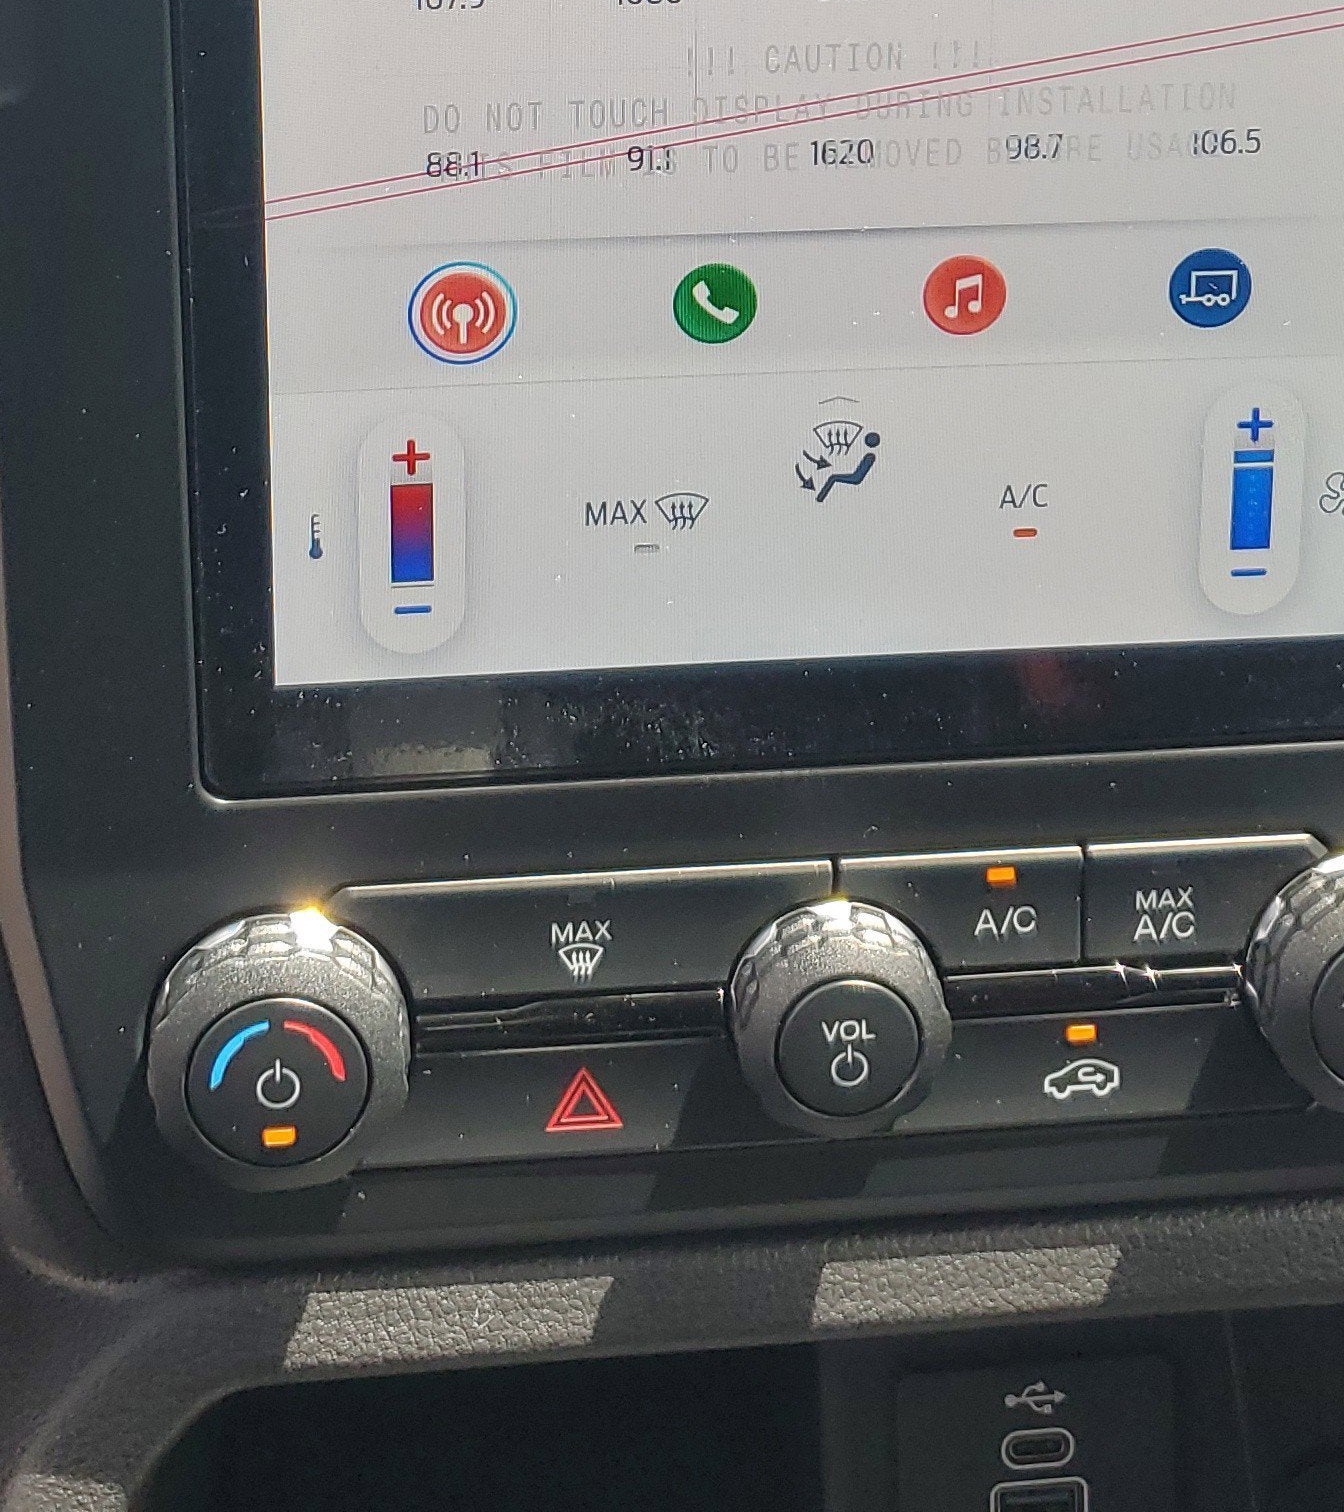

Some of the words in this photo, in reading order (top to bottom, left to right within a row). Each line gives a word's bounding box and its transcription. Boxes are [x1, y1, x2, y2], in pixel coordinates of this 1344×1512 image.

[764, 41, 903, 74] CAUTION
[423, 102, 462, 134] DO
[485, 99, 544, 133] NOT
[568, 95, 669, 128] TOUCH
[692, 90, 834, 124] DISPLAY
[855, 87, 973, 121] DURING
[999, 82, 1237, 116] INSTALLATION
[810, 138, 875, 166] 1620
[1005, 133, 1063, 160] 98.7
[1193, 128, 1261, 156] 106.5
[426, 150, 479, 178] 88.1
[703, 143, 739, 175] TO
[764, 141, 800, 171] BE
[999, 483, 1049, 509] A/C
[584, 498, 647, 527] MAX
[1135, 887, 1194, 910] MAX
[550, 921, 613, 944] MAX
[975, 906, 1037, 937] A/C
[1134, 912, 1196, 941] A/C
[821, 1020, 875, 1043] VOL
